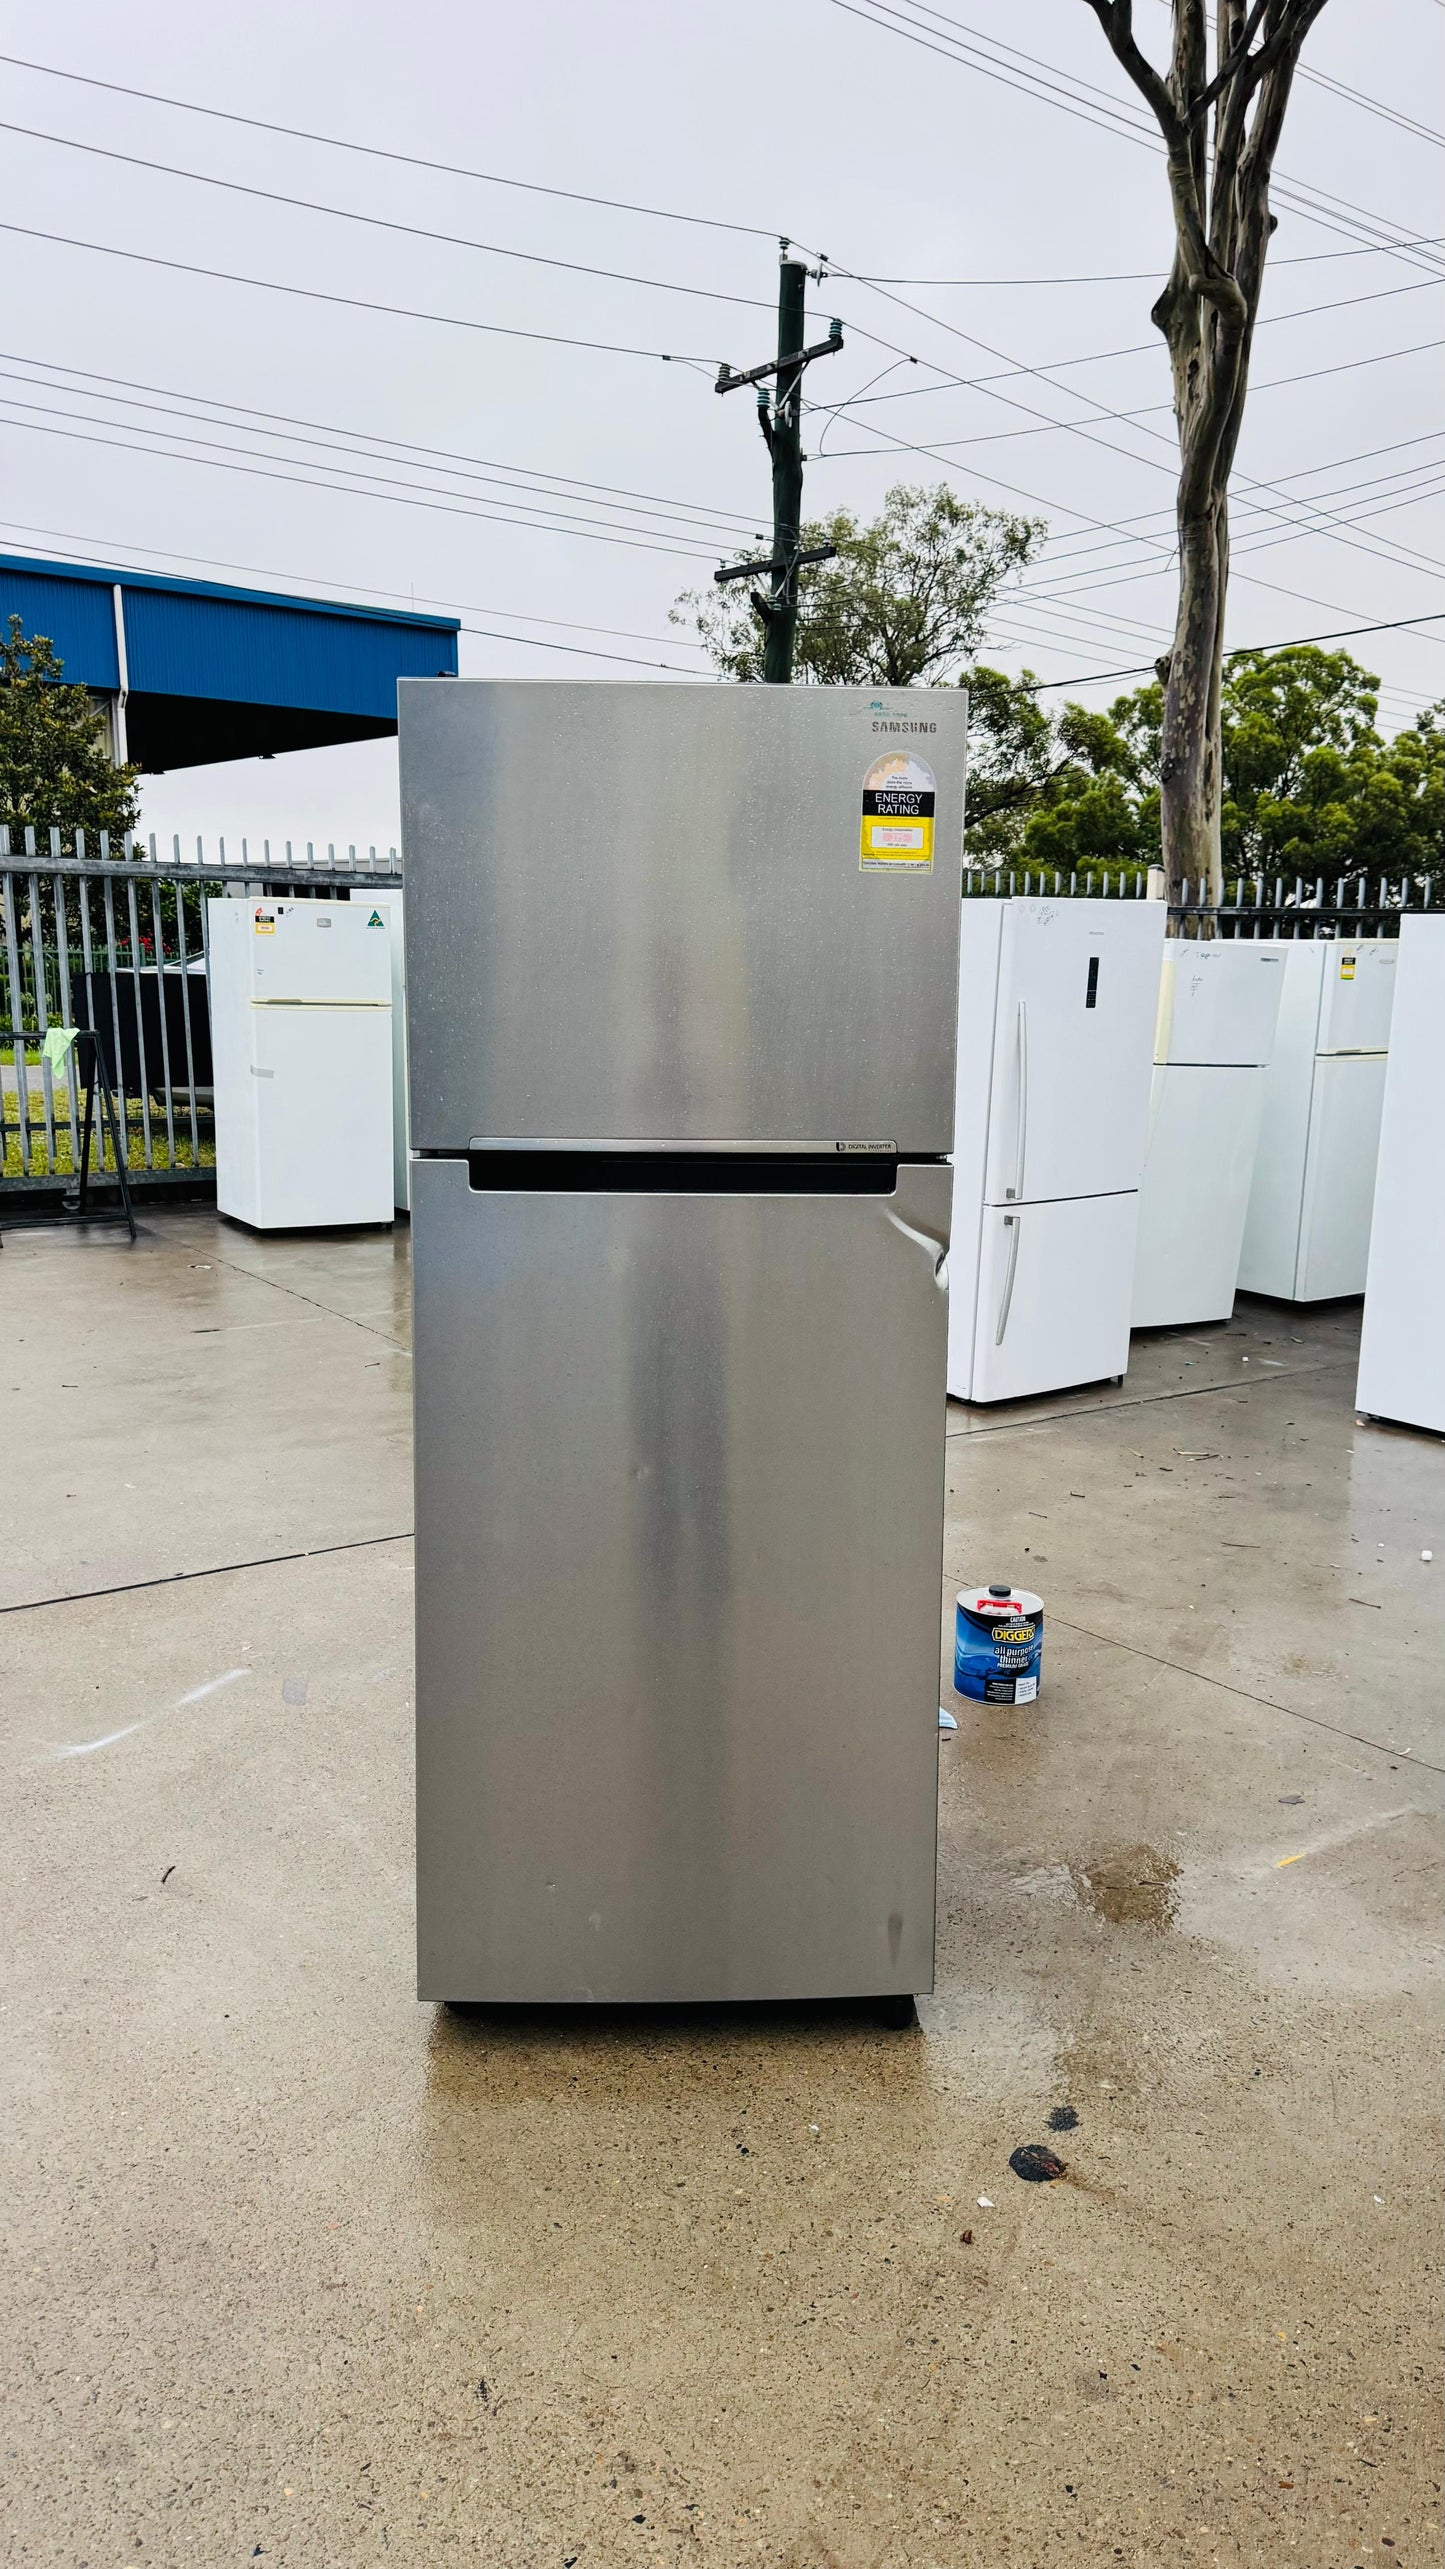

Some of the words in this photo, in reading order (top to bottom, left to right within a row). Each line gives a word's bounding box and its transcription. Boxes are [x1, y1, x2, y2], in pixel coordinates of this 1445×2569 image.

[872, 721, 937, 733] SAMSUNG
[875, 792, 923, 804] ENERGY
[877, 803, 920, 815] RATING
[994, 1646, 1006, 1654] all
